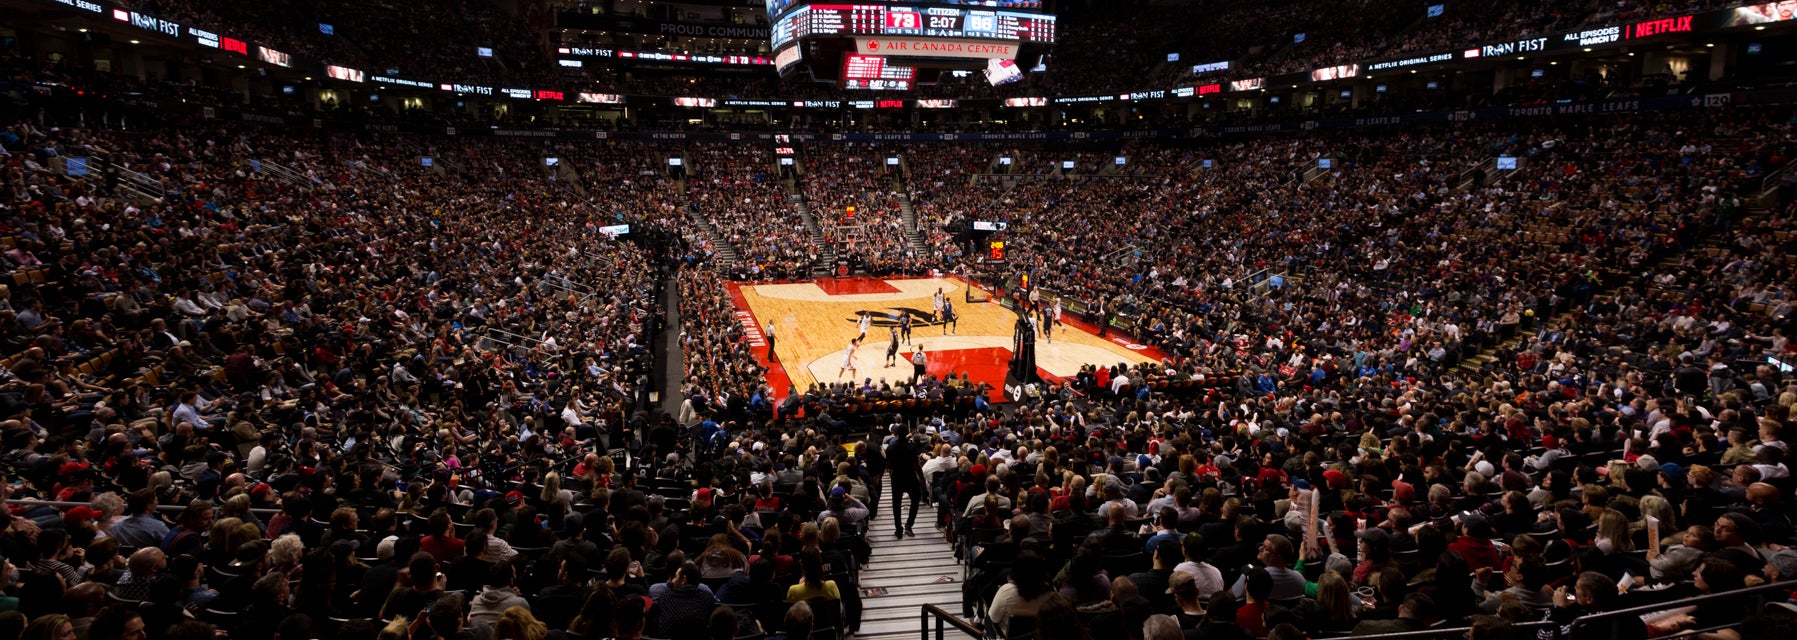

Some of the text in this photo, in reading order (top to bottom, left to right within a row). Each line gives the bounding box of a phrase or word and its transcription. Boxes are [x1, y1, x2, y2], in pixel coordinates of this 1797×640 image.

[76, 0, 102, 13] SERIES
[928, 8, 960, 17] CITIZEN
[130, 11, 158, 31] IRON
[159, 19, 180, 38] FIST
[892, 13, 915, 28] 73
[930, 17, 956, 29] 2:07
[1635, 15, 1694, 39] NETFLIX
[660, 23, 704, 36] PROUD
[1564, 27, 1620, 42] ALL EPISODES
[1579, 33, 1620, 47] MARCH 17
[571, 47, 594, 56] IRON
[595, 48, 613, 57] FIST
[886, 41, 1009, 54] AIR CANADA CENTRE
[1482, 42, 1515, 57] IRON
[1518, 37, 1548, 53] FIST
[1374, 61, 1399, 70] NETFLIX
[1399, 57, 1428, 67] ORIGINAL
[1429, 53, 1453, 63] SERIES
[453, 83, 475, 94] IRON
[476, 85, 493, 96] FIST
[538, 91, 563, 100] NETFLIX
[1130, 91, 1149, 100] IRON
[1150, 90, 1165, 99] FIST
[804, 100, 823, 108] IRON
[880, 100, 903, 108] NETFLIX
[1706, 95, 1729, 106] 120
[1509, 100, 1640, 117] TORONTO MAPLE LEAFS
[1366, 116, 1388, 126] LEAFS
